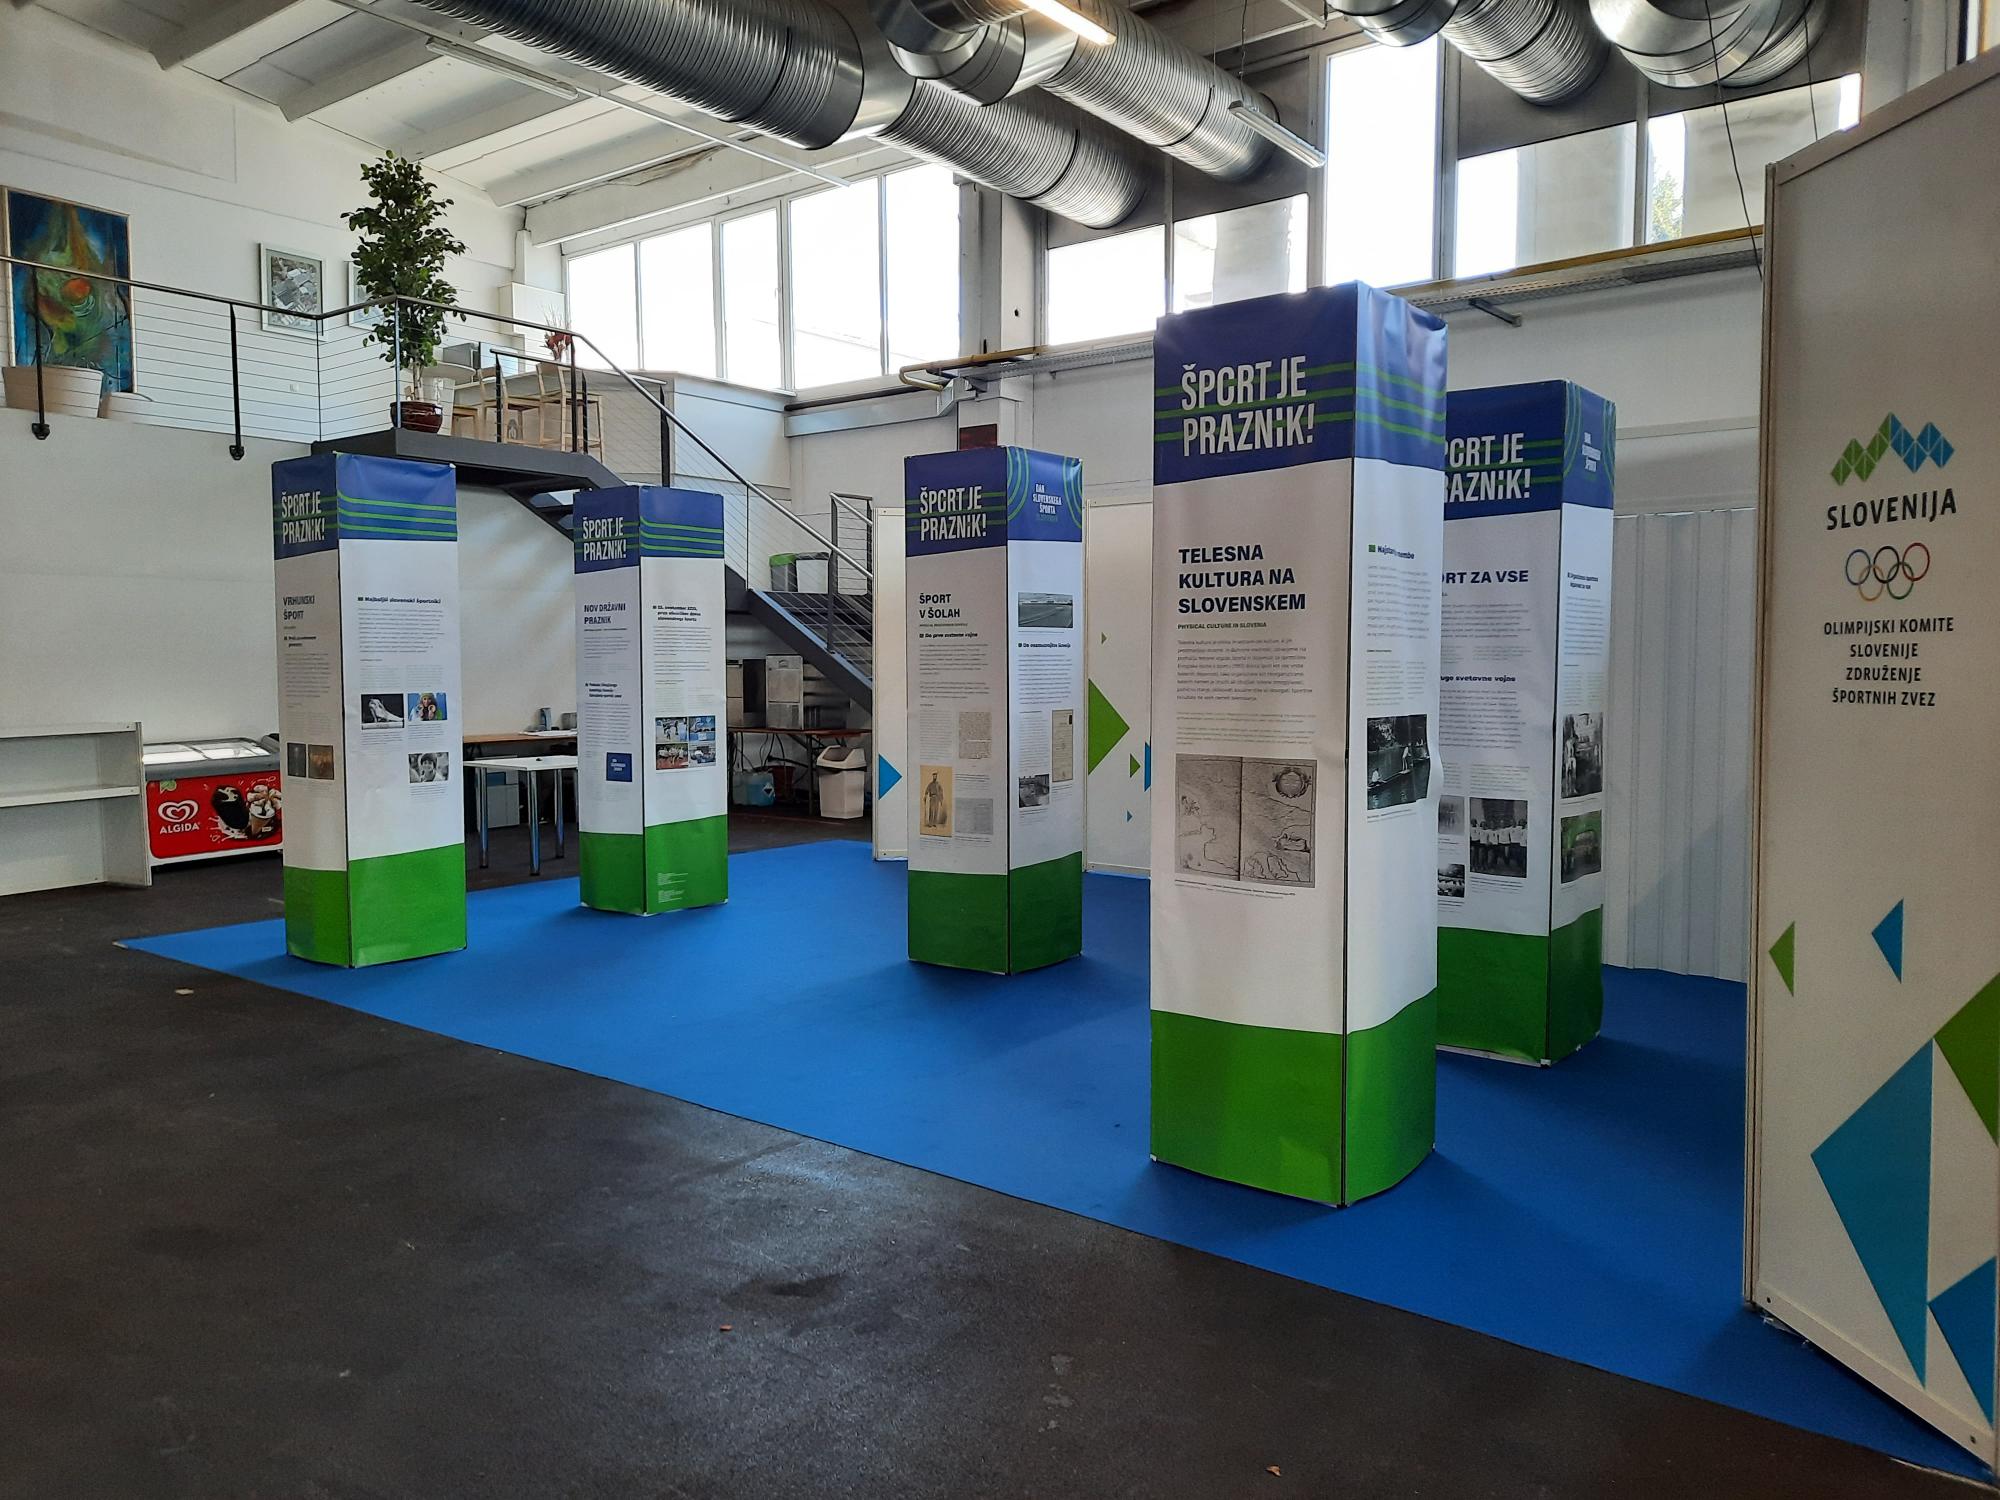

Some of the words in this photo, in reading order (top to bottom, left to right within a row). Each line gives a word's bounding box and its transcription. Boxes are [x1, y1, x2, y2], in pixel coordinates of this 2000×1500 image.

[1277, 355, 1307, 399] JE
[1183, 403, 1315, 457] PRAZNIK!
[1500, 432, 1525, 465] JE
[311, 491, 322, 513] JE
[968, 486, 982, 510] JE
[1827, 488, 1957, 530] SLOVENIJA
[282, 517, 325, 544] PRAZNIK!
[614, 516, 624, 537] JE
[920, 513, 987, 542] PRAZNIK!
[583, 538, 627, 561] PRAZNIK!
[1178, 544, 1264, 564] TELESNA
[1179, 570, 1264, 589] KULTURA
[1269, 568, 1295, 585] NA
[1470, 571, 1491, 583] ZA
[1496, 570, 1529, 583] VSE
[584, 604, 598, 613] NOV
[599, 601, 626, 612] DRŽAVNI
[919, 593, 951, 604] ŠPORT
[1178, 593, 1306, 614] SLOVENSKEM
[584, 615, 611, 624] PRAZNIK
[919, 609, 926, 618] V
[928, 607, 960, 619] ŠOLAH
[1824, 619, 1896, 637] OLIMPIJSKI
[1900, 617, 1954, 633] KOMITE
[1850, 643, 1919, 659] SLOVENIJE
[1846, 664, 1921, 683] ZDRUŽENJE
[1832, 687, 1897, 705] ŠPORTNIH
[1901, 692, 1936, 707] ZVEZ
[160, 822, 200, 834] ALGIDA
